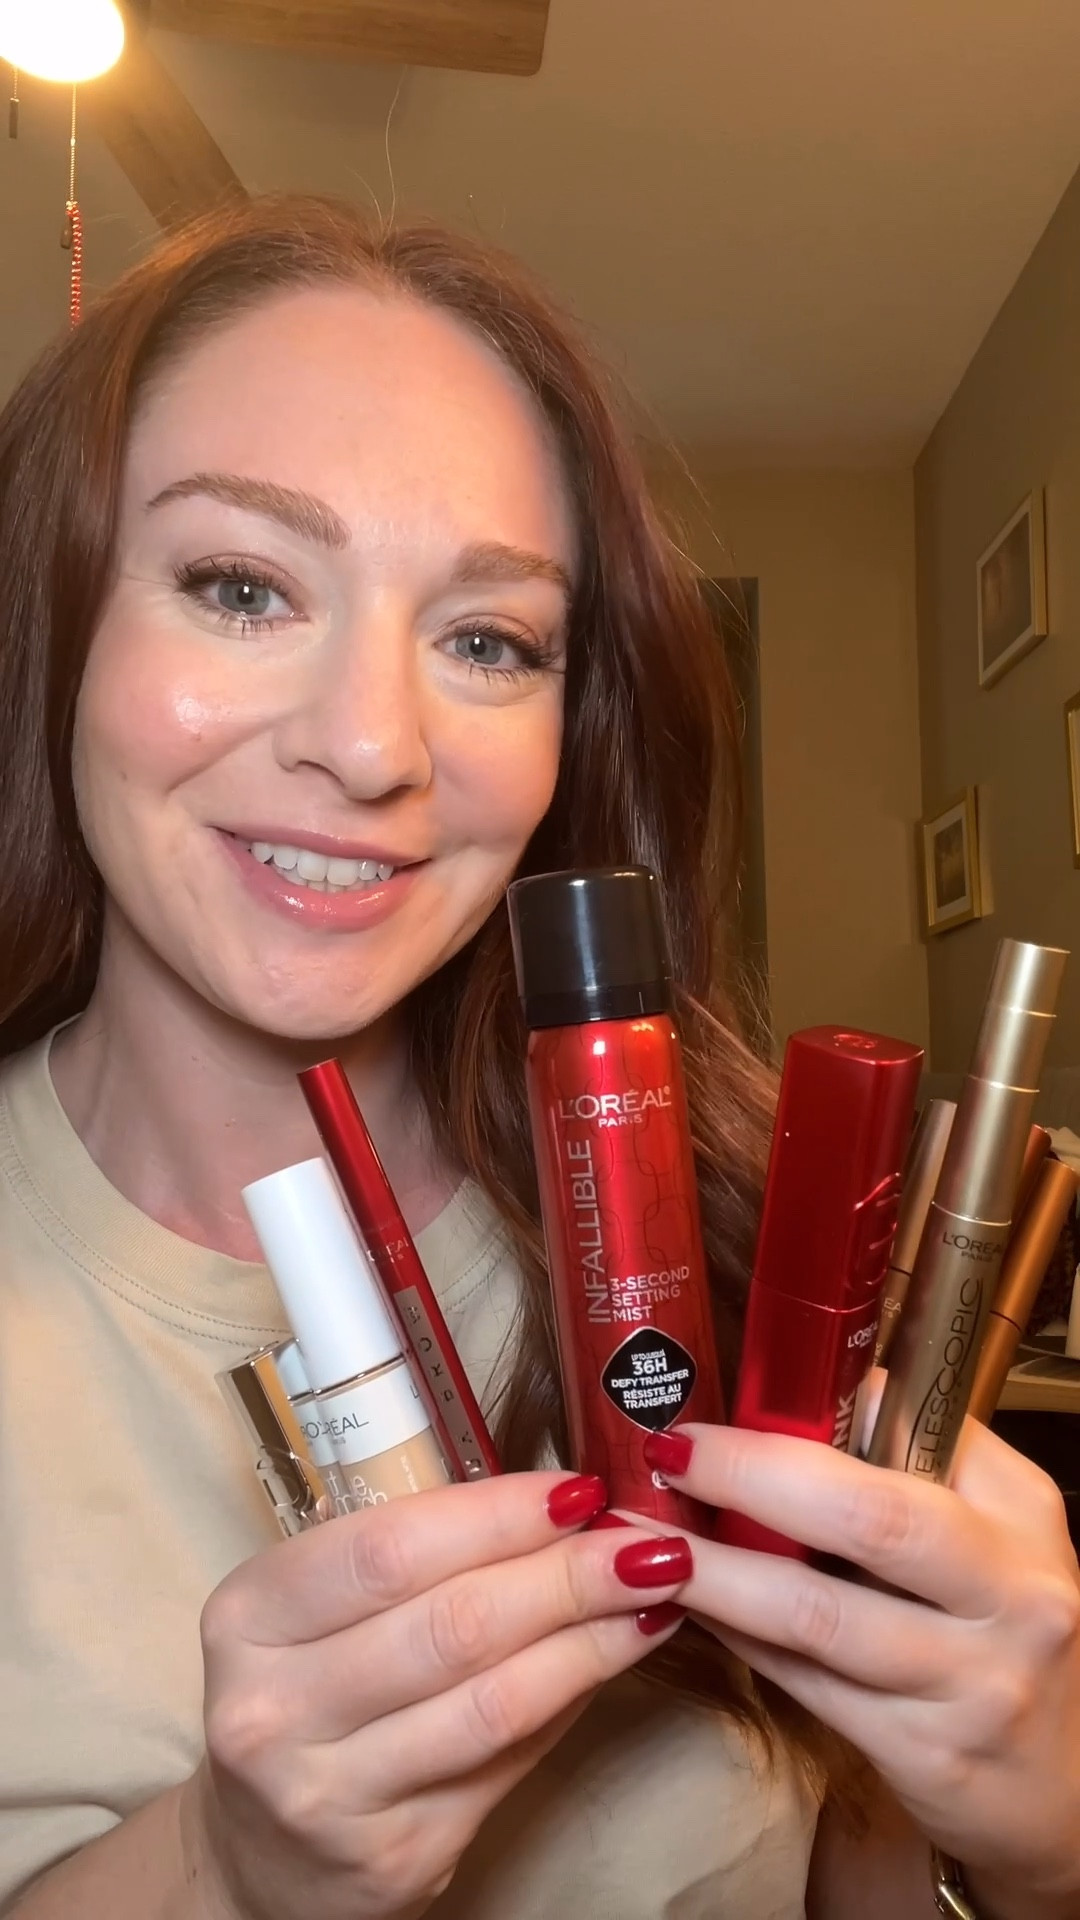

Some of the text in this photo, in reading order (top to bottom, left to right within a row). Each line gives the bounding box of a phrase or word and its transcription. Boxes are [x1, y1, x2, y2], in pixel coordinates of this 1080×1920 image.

[559, 1086, 671, 1119] L'ORÉAL
[598, 1114, 643, 1128] PARIS
[567, 1139, 611, 1324] INFALLIBLE
[610, 1266, 690, 1292] 3-SECOND
[611, 1285, 681, 1307] SETTING
[612, 1306, 653, 1323] MIST
[632, 1357, 668, 1376] 36H
[914, 1277, 980, 1475] ELESCOPIC
[611, 1369, 690, 1389] DEFY TRANSFER
[623, 1383, 682, 1400] RÉSISTE AU
[624, 1392, 683, 1410] TRANSFERT
